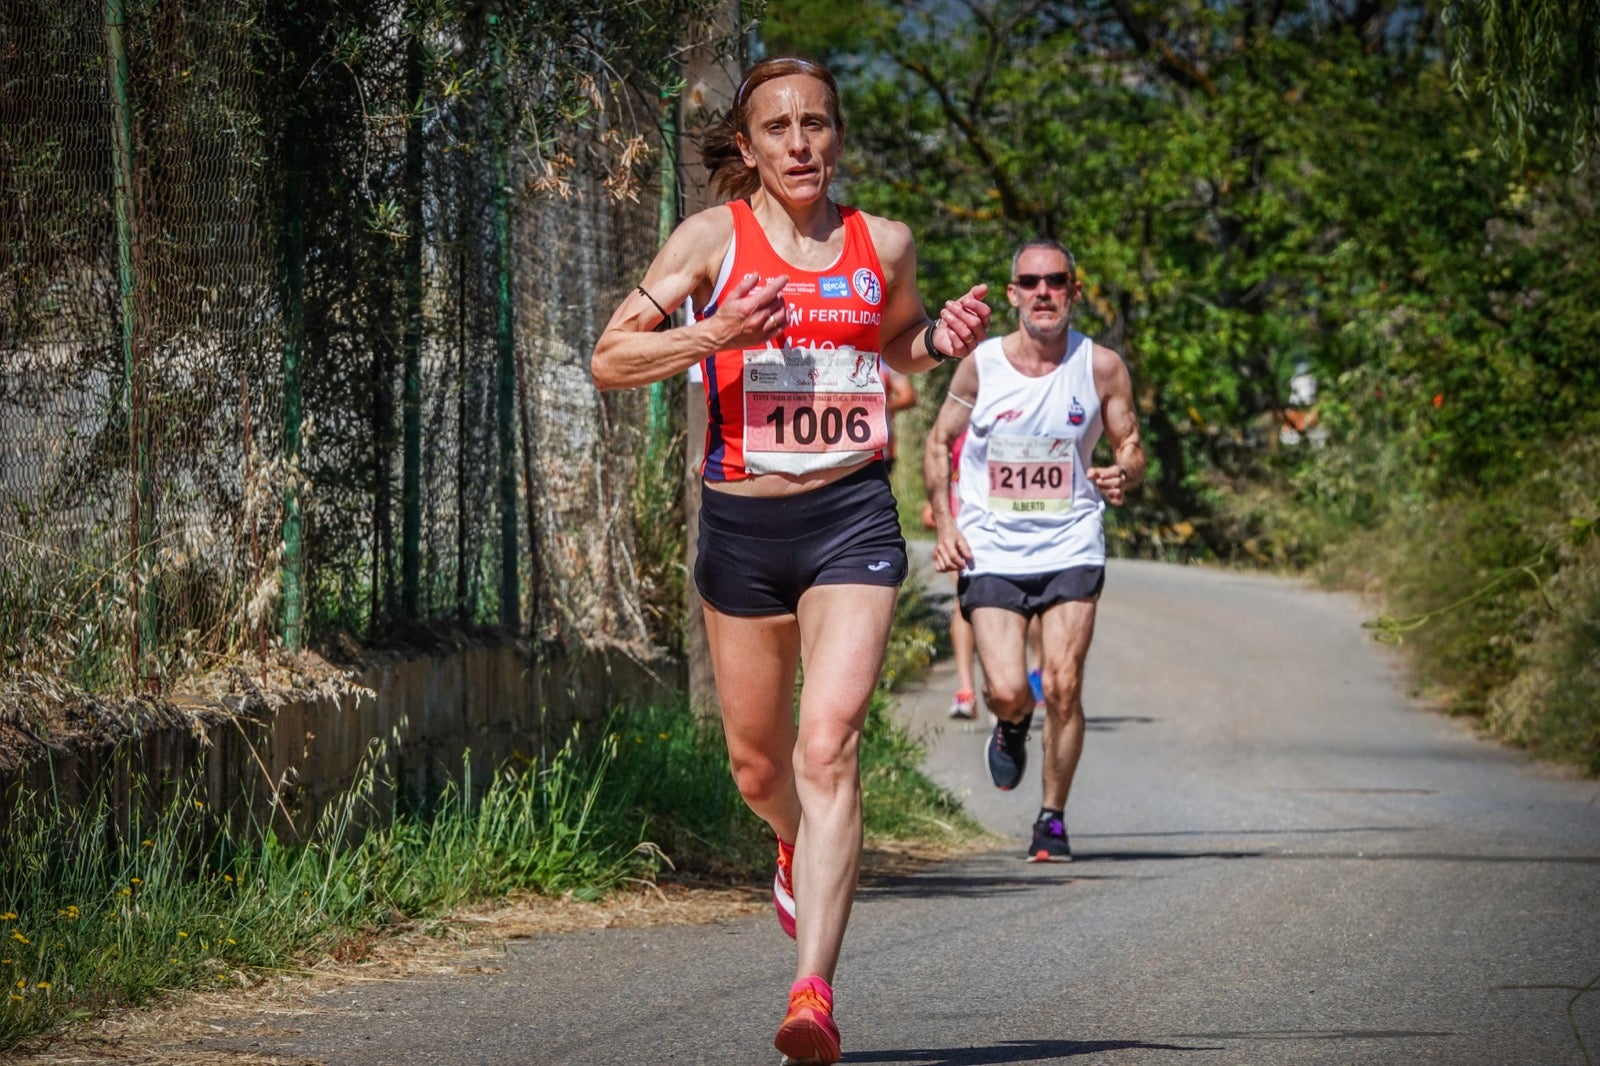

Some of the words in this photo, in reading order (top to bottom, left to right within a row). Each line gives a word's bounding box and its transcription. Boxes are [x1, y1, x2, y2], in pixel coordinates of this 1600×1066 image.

[809, 309, 881, 326] FERTILIDAD
[766, 406, 871, 445] 1006
[1000, 466, 1063, 490] 2140
[1012, 501, 1045, 512] ALBERTO
